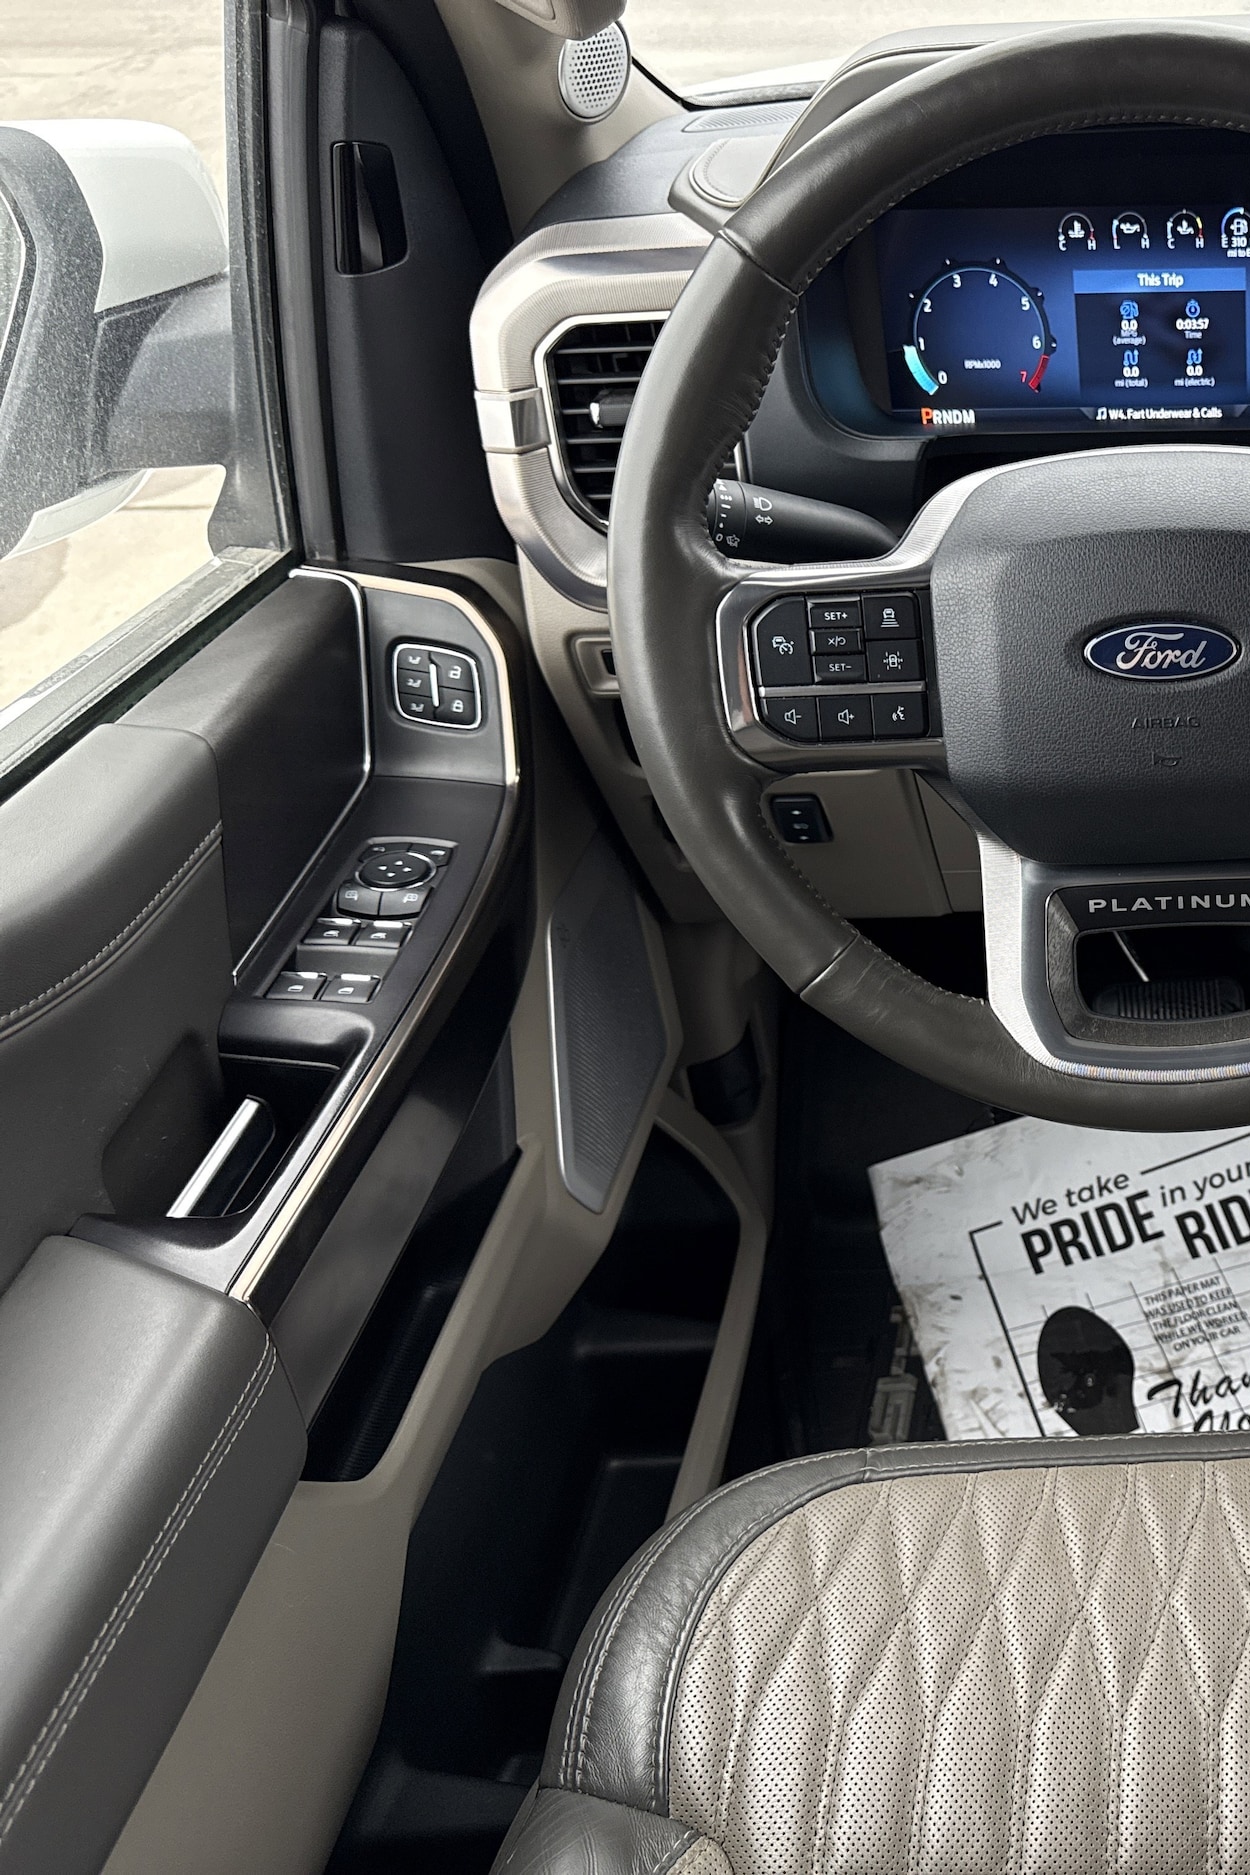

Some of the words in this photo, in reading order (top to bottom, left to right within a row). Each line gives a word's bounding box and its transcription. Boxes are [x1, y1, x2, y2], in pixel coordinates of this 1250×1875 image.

[1059, 240, 1067, 251] C
[1087, 239, 1097, 251] H
[1113, 239, 1121, 249] L
[1141, 238, 1150, 249] H
[1167, 238, 1175, 249] C
[1195, 238, 1204, 249] H
[1221, 237, 1229, 248] E
[1231, 236, 1247, 248] 310
[1227, 249, 1237, 258] mi
[1237, 249, 1246, 258] to
[952, 273, 962, 288] 3
[988, 273, 999, 288] 4
[1137, 273, 1161, 287] This
[1162, 272, 1184, 288] Trip
[923, 299, 932, 313] 2
[1020, 296, 1030, 311] 5
[1121, 318, 1138, 331] 0.0
[1175, 318, 1210, 331] 0:03:57
[1112, 335, 1147, 346] (average)
[1184, 330, 1203, 340] Time
[918, 336, 926, 351] 1
[1032, 335, 1042, 350] 6
[1020, 371, 1028, 383] 7
[1123, 366, 1140, 378] 0.0
[1186, 365, 1203, 377] 0.0
[937, 371, 948, 385] 0
[1114, 378, 1125, 388] mi
[1125, 378, 1149, 389] (total)
[1174, 378, 1184, 388] mi
[1185, 377, 1216, 388] (electric)
[1127, 408, 1145, 421] Fart
[1146, 407, 1192, 421] Underwear
[1201, 407, 1223, 420] Calls
[824, 611, 848, 621] SET+
[1116, 631, 1208, 670] Ford
[1131, 716, 1200, 730] AIRBAG
[1011, 1196, 1058, 1226] We
[1065, 1173, 1130, 1208] take
[1159, 1185, 1187, 1208] in
[1020, 1189, 1166, 1276] PRIDE
[1144, 1290, 1168, 1305] THIS
[1168, 1281, 1200, 1298] PAPER
[1200, 1275, 1221, 1290] MAT
[1145, 1305, 1168, 1319] WAS
[1168, 1297, 1194, 1313] USED
[1193, 1295, 1208, 1308] TO
[1209, 1286, 1233, 1302] KEEP
[1206, 1300, 1240, 1318] CLEAN
[1154, 1327, 1187, 1344] WHILE
[1204, 1311, 1247, 1328] WORKED
[1173, 1340, 1191, 1352] ON
[1191, 1332, 1218, 1347] YOUR
[1219, 1325, 1240, 1338] CAR
